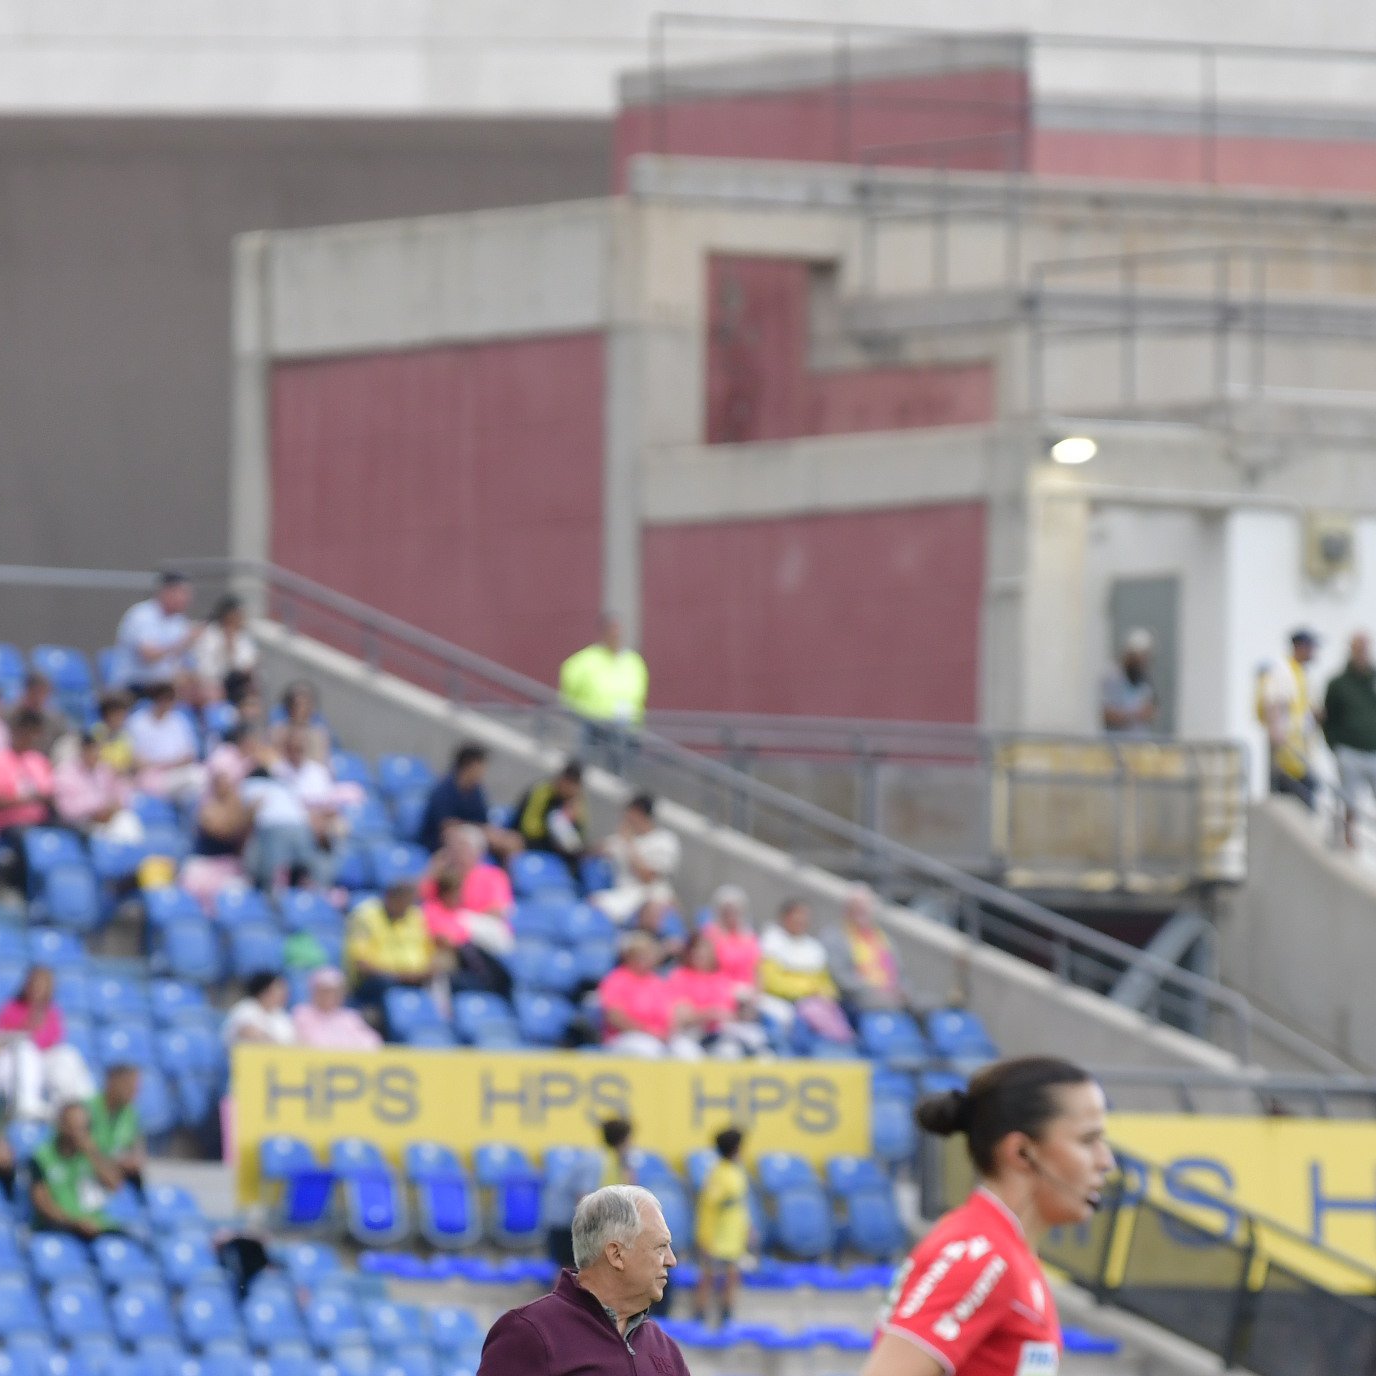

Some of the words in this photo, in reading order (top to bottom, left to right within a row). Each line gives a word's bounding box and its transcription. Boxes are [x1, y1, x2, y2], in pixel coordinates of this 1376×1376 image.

[264, 1064, 422, 1126] HPS
[480, 1068, 633, 1129] HPS
[691, 1073, 841, 1134] HPS
